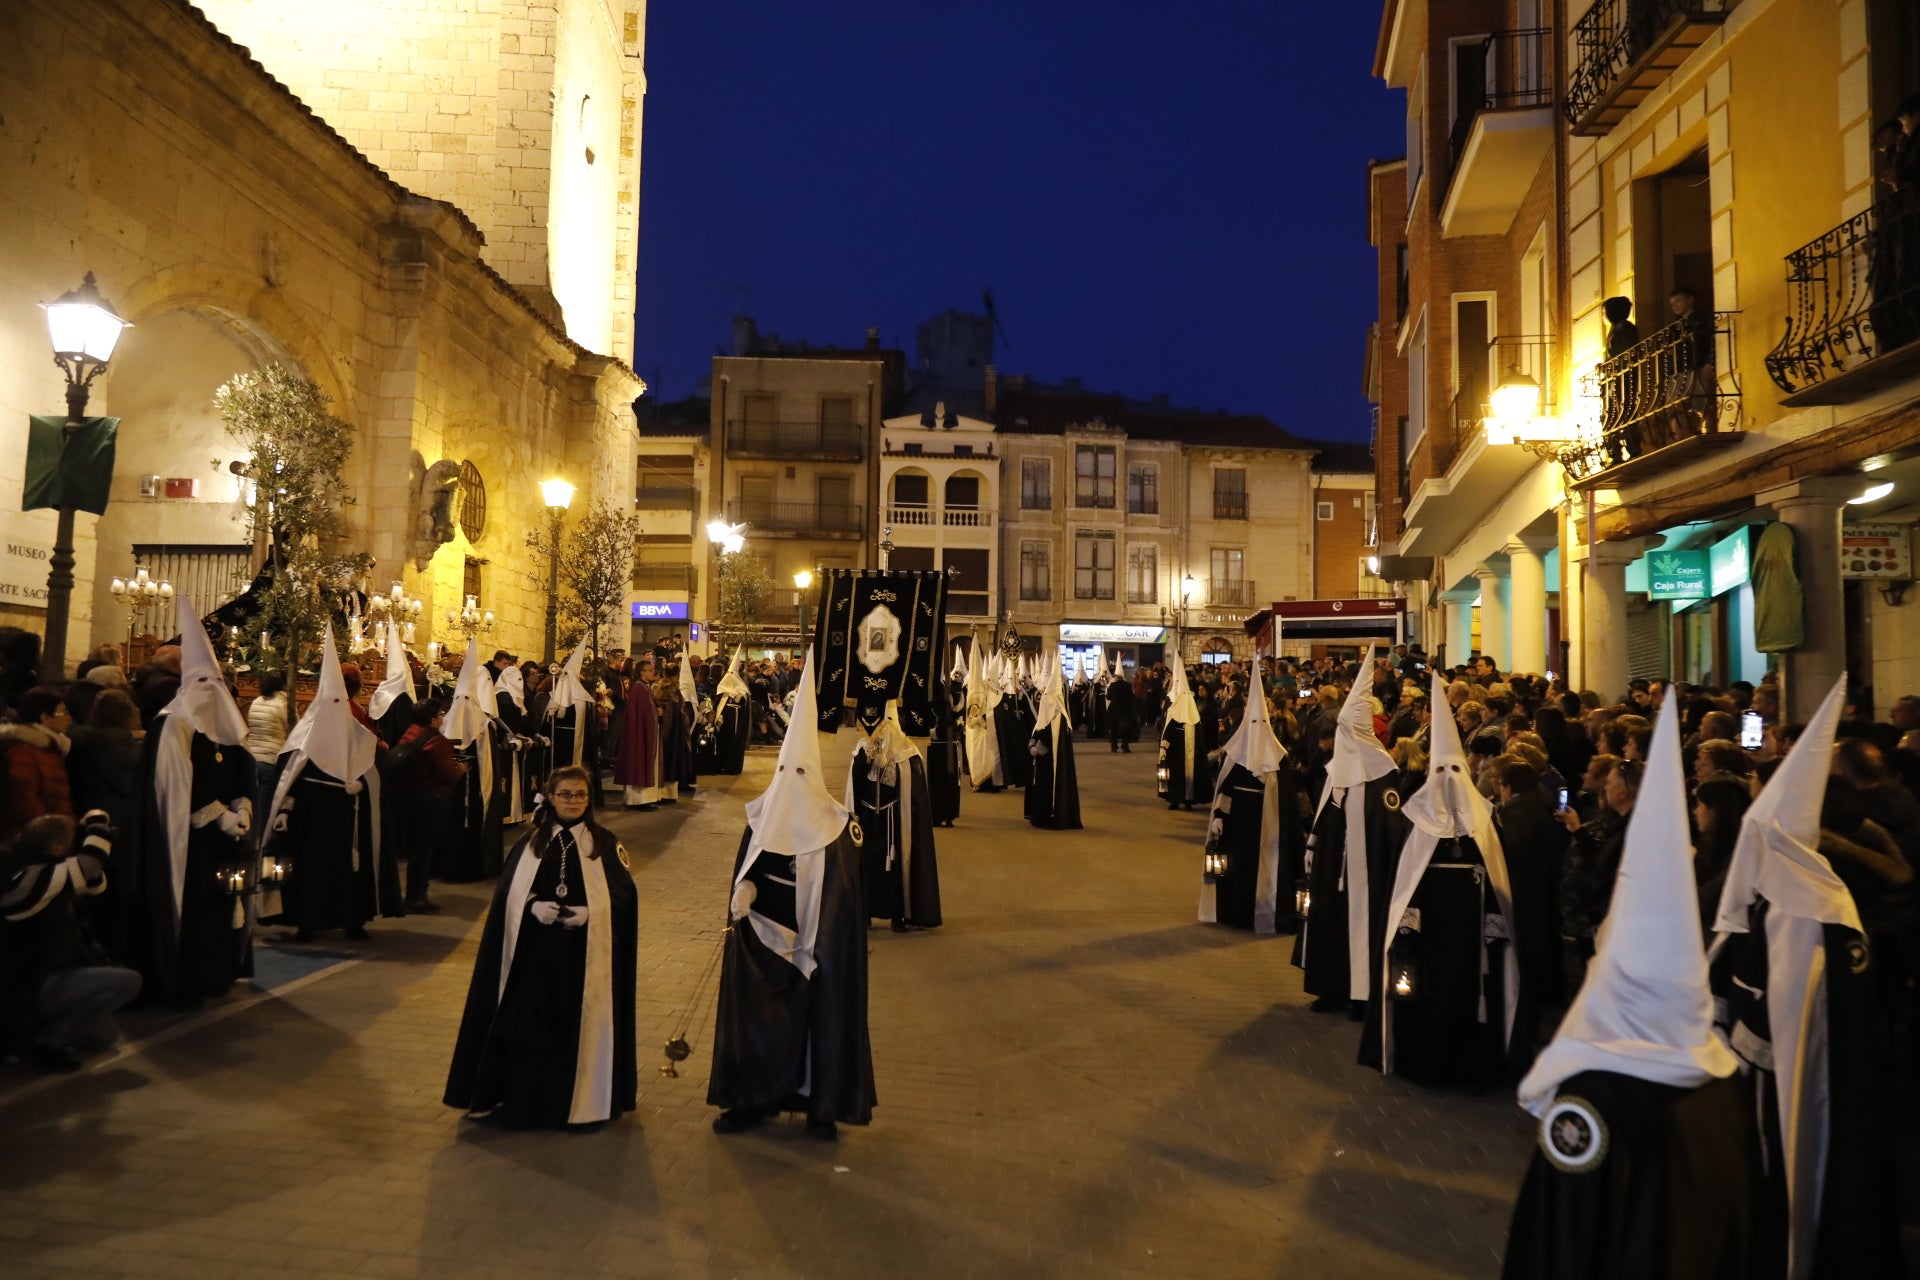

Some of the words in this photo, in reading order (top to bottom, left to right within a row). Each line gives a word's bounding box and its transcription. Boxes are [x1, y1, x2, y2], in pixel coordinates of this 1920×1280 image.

[7, 544, 47, 561] MUSEO
[0, 583, 20, 596] RTE
[22, 586, 49, 600] SACR
[1654, 581, 1675, 591] Caja
[1677, 580, 1704, 589] Rural
[639, 604, 672, 616] BBVA
